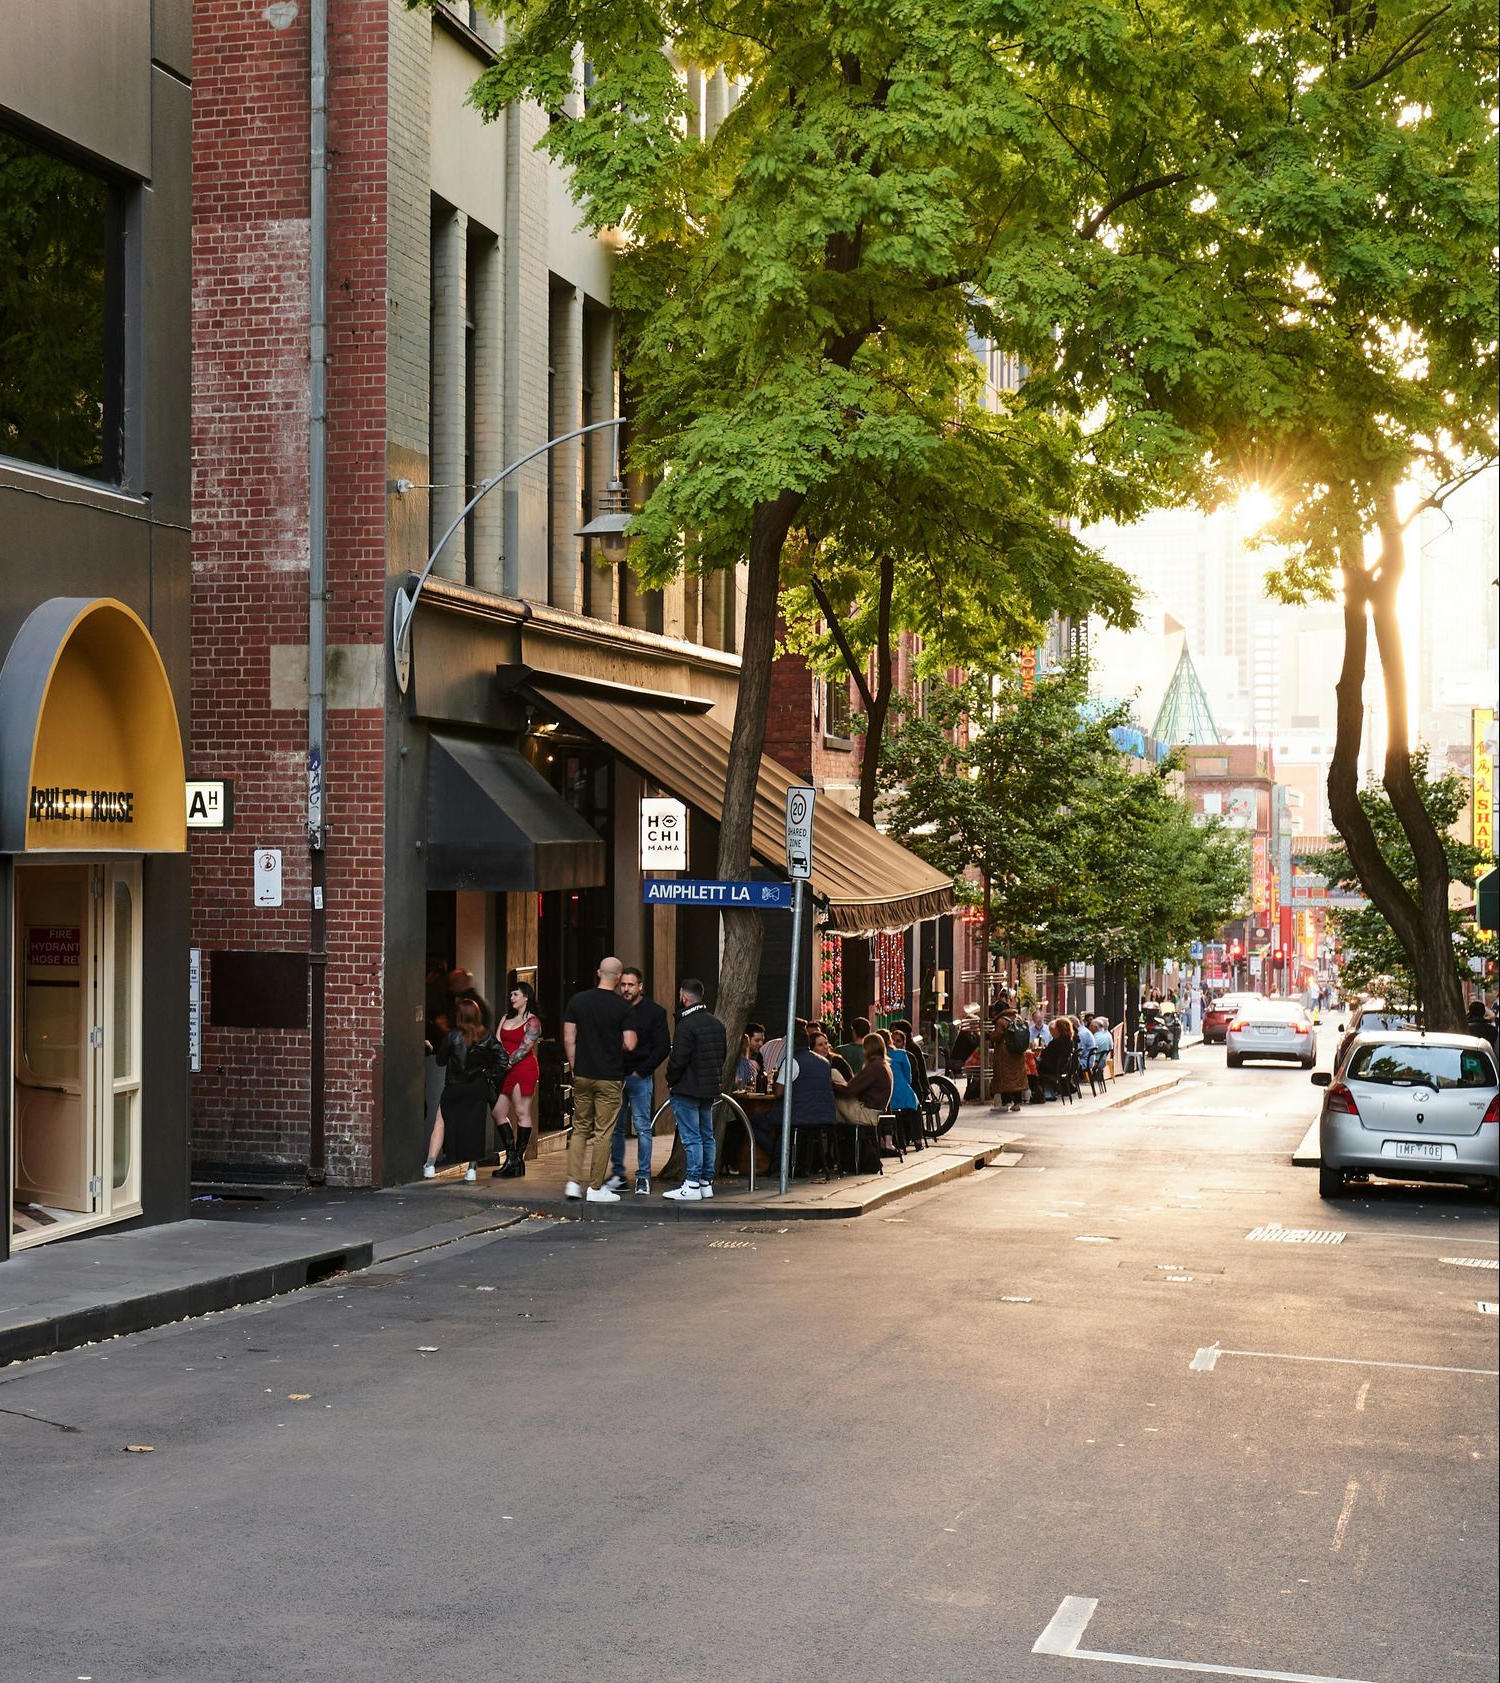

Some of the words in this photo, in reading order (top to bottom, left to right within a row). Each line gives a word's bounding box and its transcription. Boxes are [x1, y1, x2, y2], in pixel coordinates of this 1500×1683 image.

[90, 790, 133, 823] HOUSE
[793, 802, 804, 816] 20
[648, 831, 678, 841] CHI
[788, 827, 807, 837] SHARED
[789, 838, 802, 848] ZONE
[648, 884, 726, 900] AMPHLETT
[731, 887, 750, 901] LA
[50, 929, 73, 939] FIRE
[31, 942, 80, 952] HYDRANT
[32, 955, 60, 965] HOSE
[63, 955, 80, 965] RE
